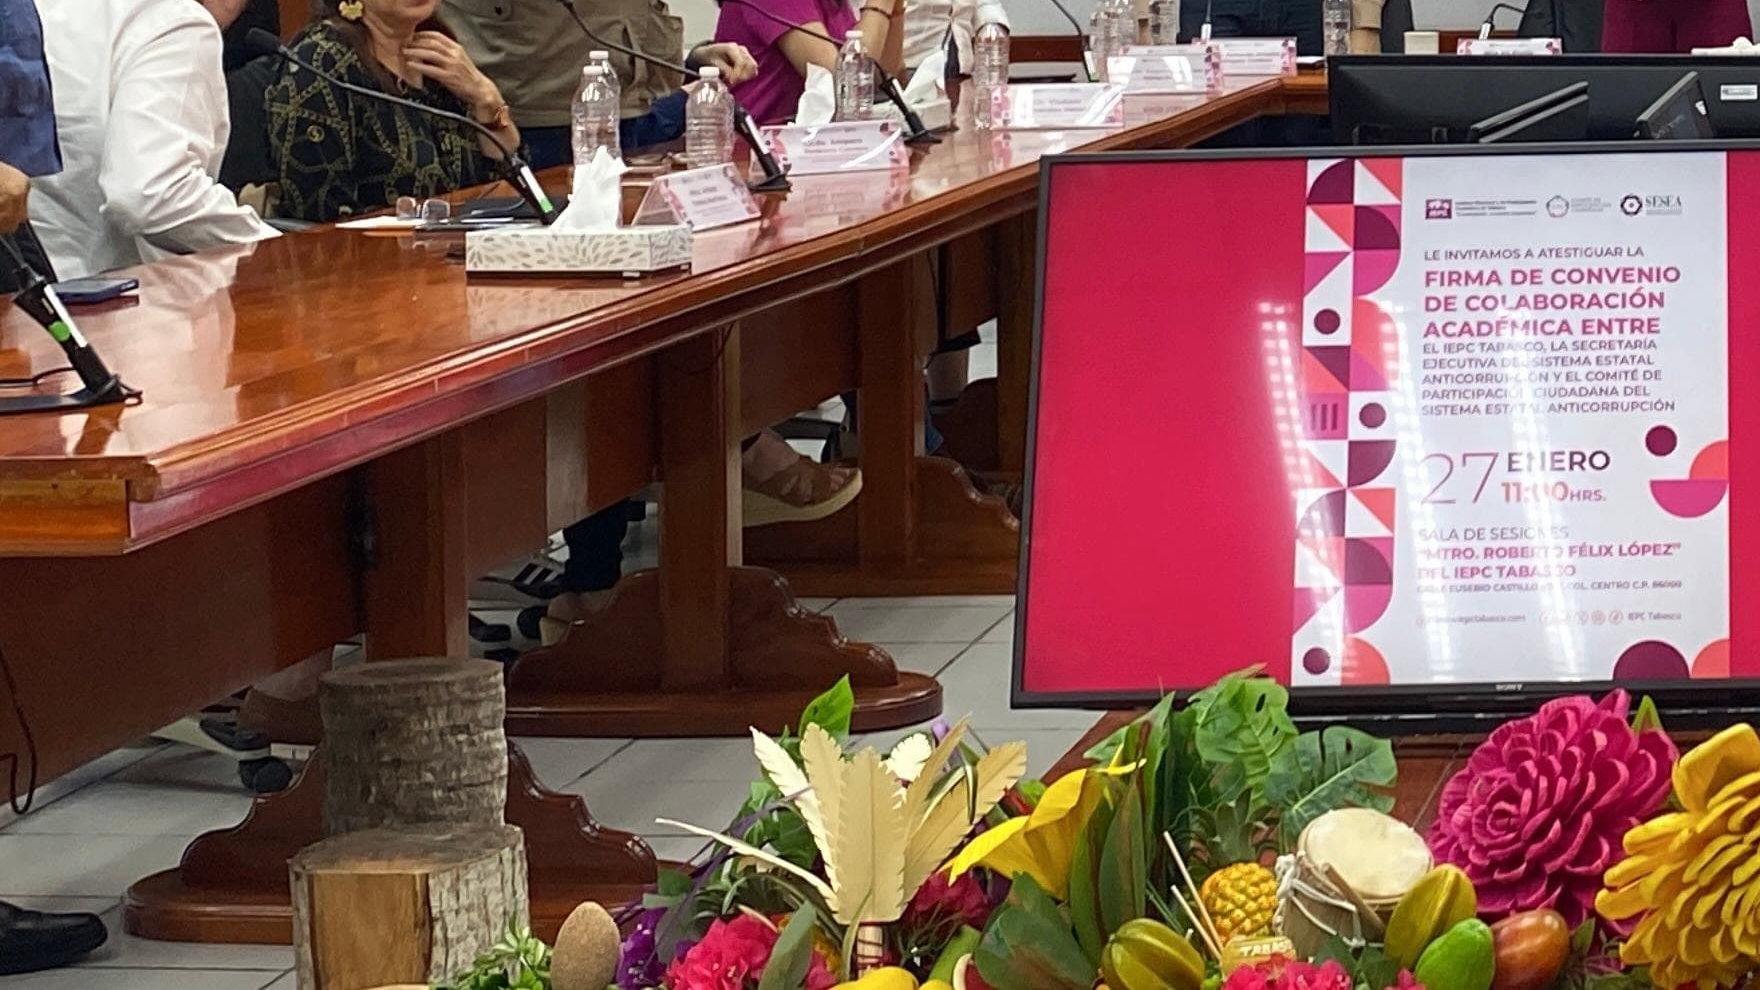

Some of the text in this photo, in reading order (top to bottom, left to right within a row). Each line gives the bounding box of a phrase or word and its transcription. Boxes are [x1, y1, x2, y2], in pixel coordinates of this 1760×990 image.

[1424, 246, 1645, 261] LE INVITAMOS A ATESTIGUAR LA
[1424, 266, 1682, 288] FIRMA DE CONVENIO
[1424, 286, 1666, 312] DE COLABORACIÓN
[1423, 315, 1661, 338] ACADÉMICA ENTRE
[1423, 343, 1440, 354] EL
[1443, 342, 1476, 354] IEPC
[1550, 340, 1568, 352] LA
[1571, 337, 1658, 351] SECRETARÍA
[1423, 357, 1498, 370] EJECUTIVA
[1532, 355, 1592, 368] SISTEMA
[1595, 354, 1655, 366] ESTATAL
[1422, 368, 1663, 385] ANTICORRUCÓN Y EL COMITÉ DE
[1422, 385, 1651, 400] PARTICIPACIÓ CIUDADANA DEL
[1421, 404, 1481, 416] SISTEMA
[1547, 398, 1676, 413] ANTICORRUPCIÓN
[1420, 450, 1611, 504] 27 ENERO
[1418, 528, 1460, 541] SALA
[1463, 527, 1487, 541] DE
[1568, 542, 1614, 558] FÉLIX
[1454, 566, 1493, 579] IEPC
